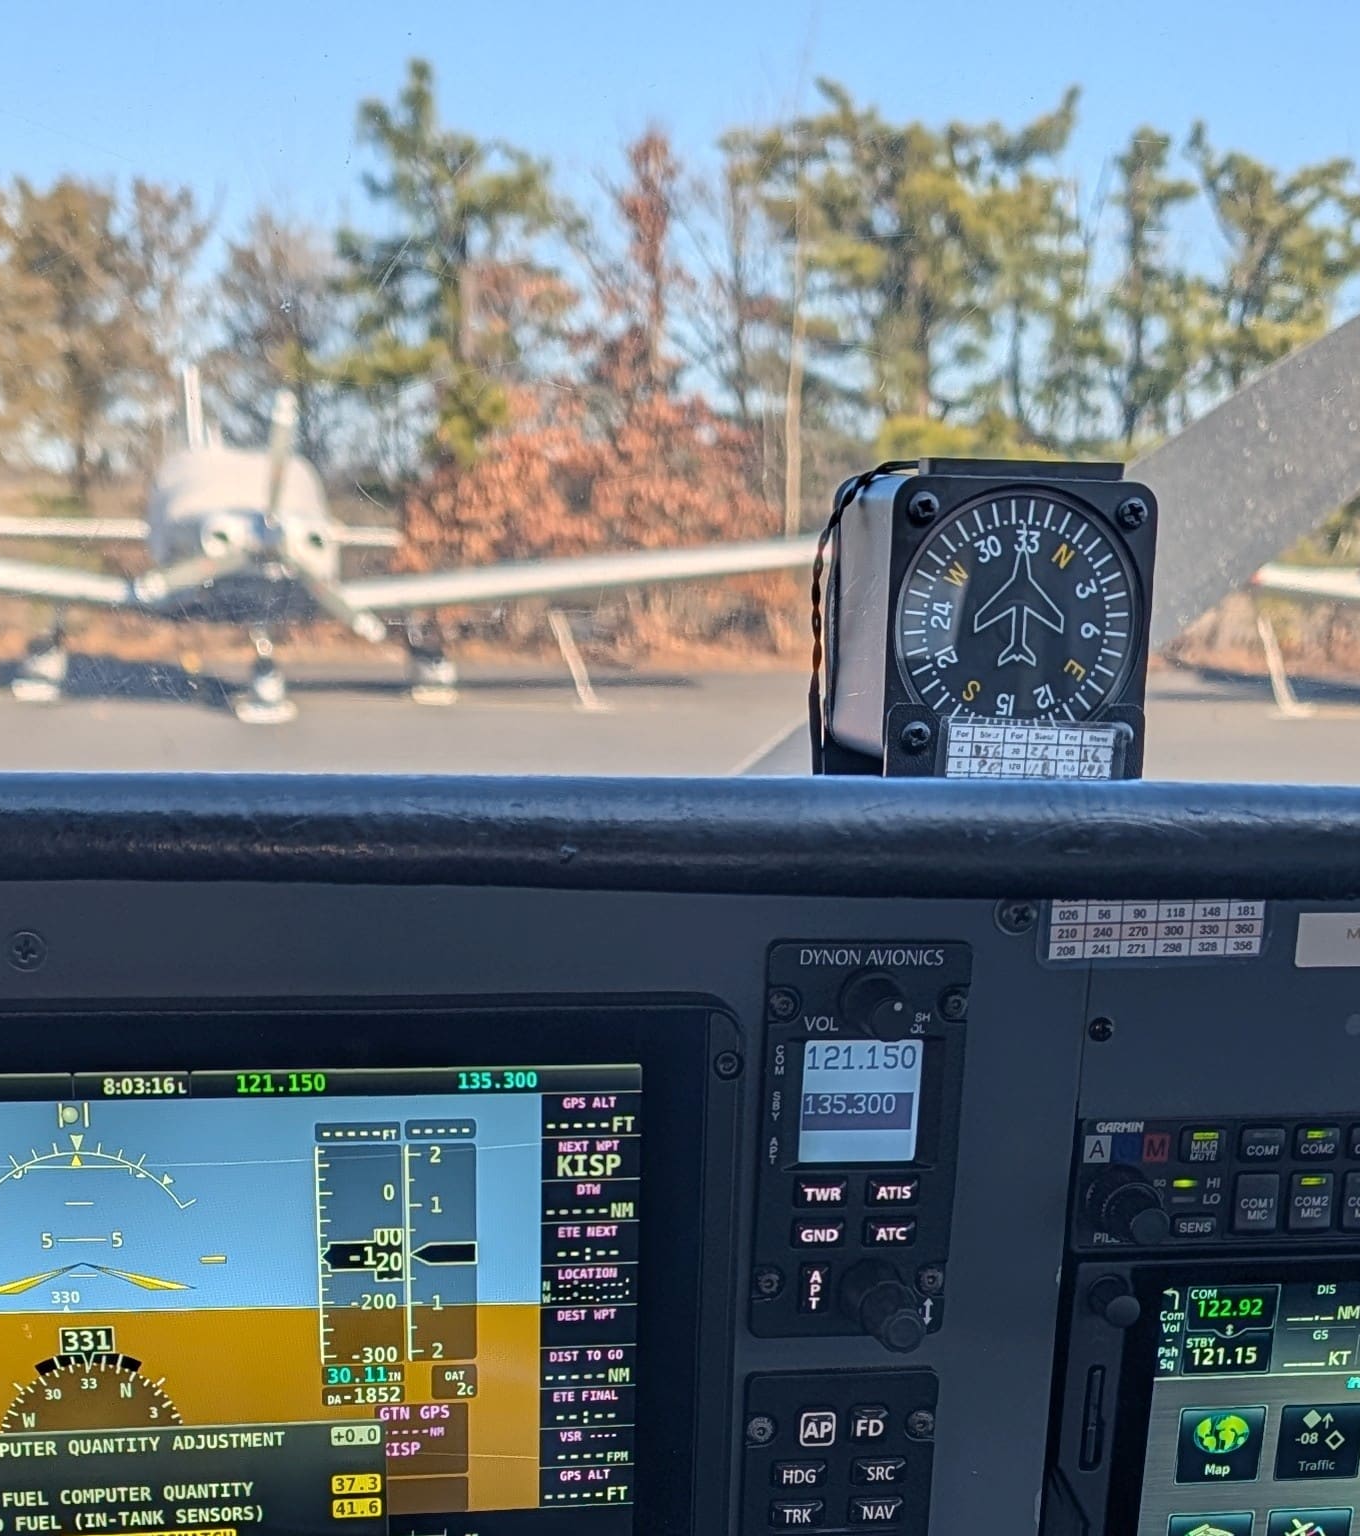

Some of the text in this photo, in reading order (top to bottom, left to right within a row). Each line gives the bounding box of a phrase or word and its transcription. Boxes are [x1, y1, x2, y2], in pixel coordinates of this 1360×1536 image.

[974, 536, 1002, 563] 30
[1013, 529, 1040, 553] 33
[1051, 543, 1075, 569] N
[943, 562, 969, 587] W
[1076, 579, 1098, 599] 3
[931, 601, 953, 630] 24
[934, 645, 958, 668] 21
[1064, 659, 1086, 682] E
[962, 680, 981, 701] S
[1033, 683, 1055, 708] 12
[996, 693, 1014, 716] 15
[1058, 928, 1077, 939] 210
[1093, 927, 1112, 938] 240
[1128, 927, 1148, 937] 270
[1164, 926, 1184, 936] 300
[1199, 925, 1219, 935] 330
[800, 949, 944, 966] DYNON AVIONICS
[805, 1017, 839, 1031] VOL
[806, 1045, 917, 1070] 121.150
[236, 1073, 326, 1093] 121.150
[458, 1071, 538, 1090] 135.300
[563, 1097, 616, 1109] GPS ALT
[804, 1094, 896, 1115] 135.300
[559, 1140, 619, 1152] NEXT WPT
[1246, 1145, 1280, 1156] COM1
[1300, 1144, 1335, 1154] COM2
[557, 1154, 622, 1177] KISP
[804, 1187, 842, 1202] TWR
[876, 1187, 911, 1199] ATIS
[558, 1225, 617, 1238] ETE NEXT
[801, 1228, 839, 1242] GND
[876, 1227, 907, 1241] ATC
[1179, 1222, 1212, 1233] SENS
[558, 1267, 617, 1280] LOCATION
[1197, 1299, 1263, 1318] 122.92
[63, 1331, 111, 1351] 331
[1191, 1347, 1258, 1366] 121.15
[380, 1406, 450, 1420] GTN GPS
[804, 1421, 832, 1438] AP
[856, 1419, 884, 1437] FD
[68, 1436, 161, 1456] QUANTITY
[172, 1431, 284, 1451] ADJUSTMENT
[782, 1469, 816, 1484] HDG
[866, 1466, 895, 1481] SRC
[1204, 1462, 1230, 1478] Map
[334, 1475, 378, 1492] 37.3
[1, 1490, 49, 1508] FUEL
[60, 1487, 152, 1505] COMPUTER
[163, 1482, 254, 1501] QUANTITY
[15, 1514, 62, 1531] FUEL
[74, 1508, 164, 1530] (IN-TANK
[175, 1504, 264, 1525] SENSORS)
[335, 1501, 378, 1517] 41.6
[783, 1510, 811, 1523] TRK
[862, 1505, 895, 1520] NAV
